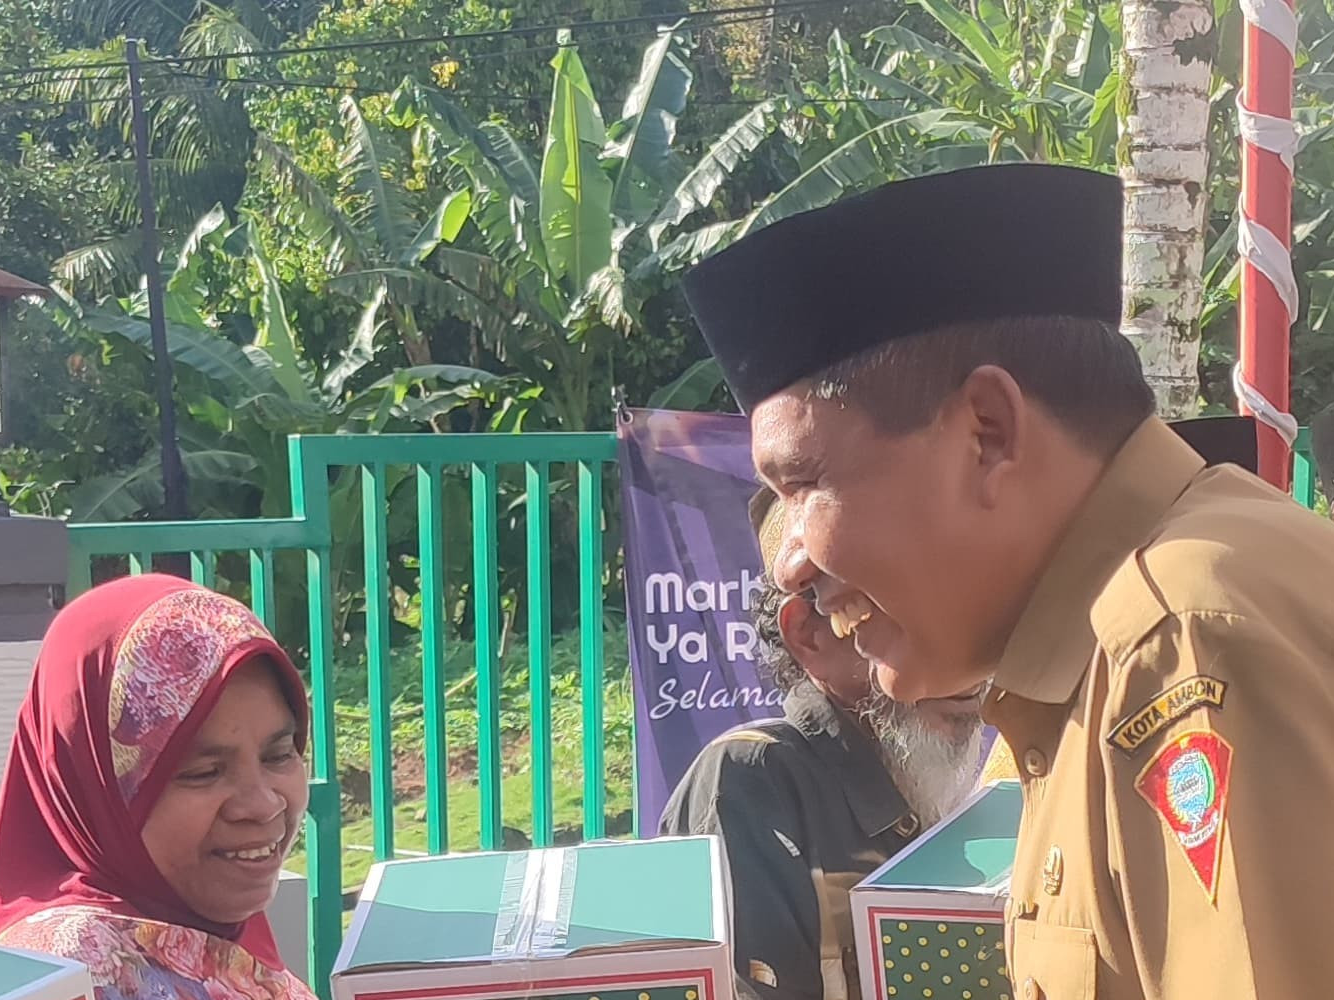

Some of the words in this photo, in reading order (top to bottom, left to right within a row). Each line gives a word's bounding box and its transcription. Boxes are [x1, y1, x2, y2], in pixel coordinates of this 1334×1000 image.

[646, 622, 708, 664] Ya
[649, 670, 785, 720] Selama
[1122, 706, 1164, 746] KOTA
[1166, 679, 1217, 710] AMBON
